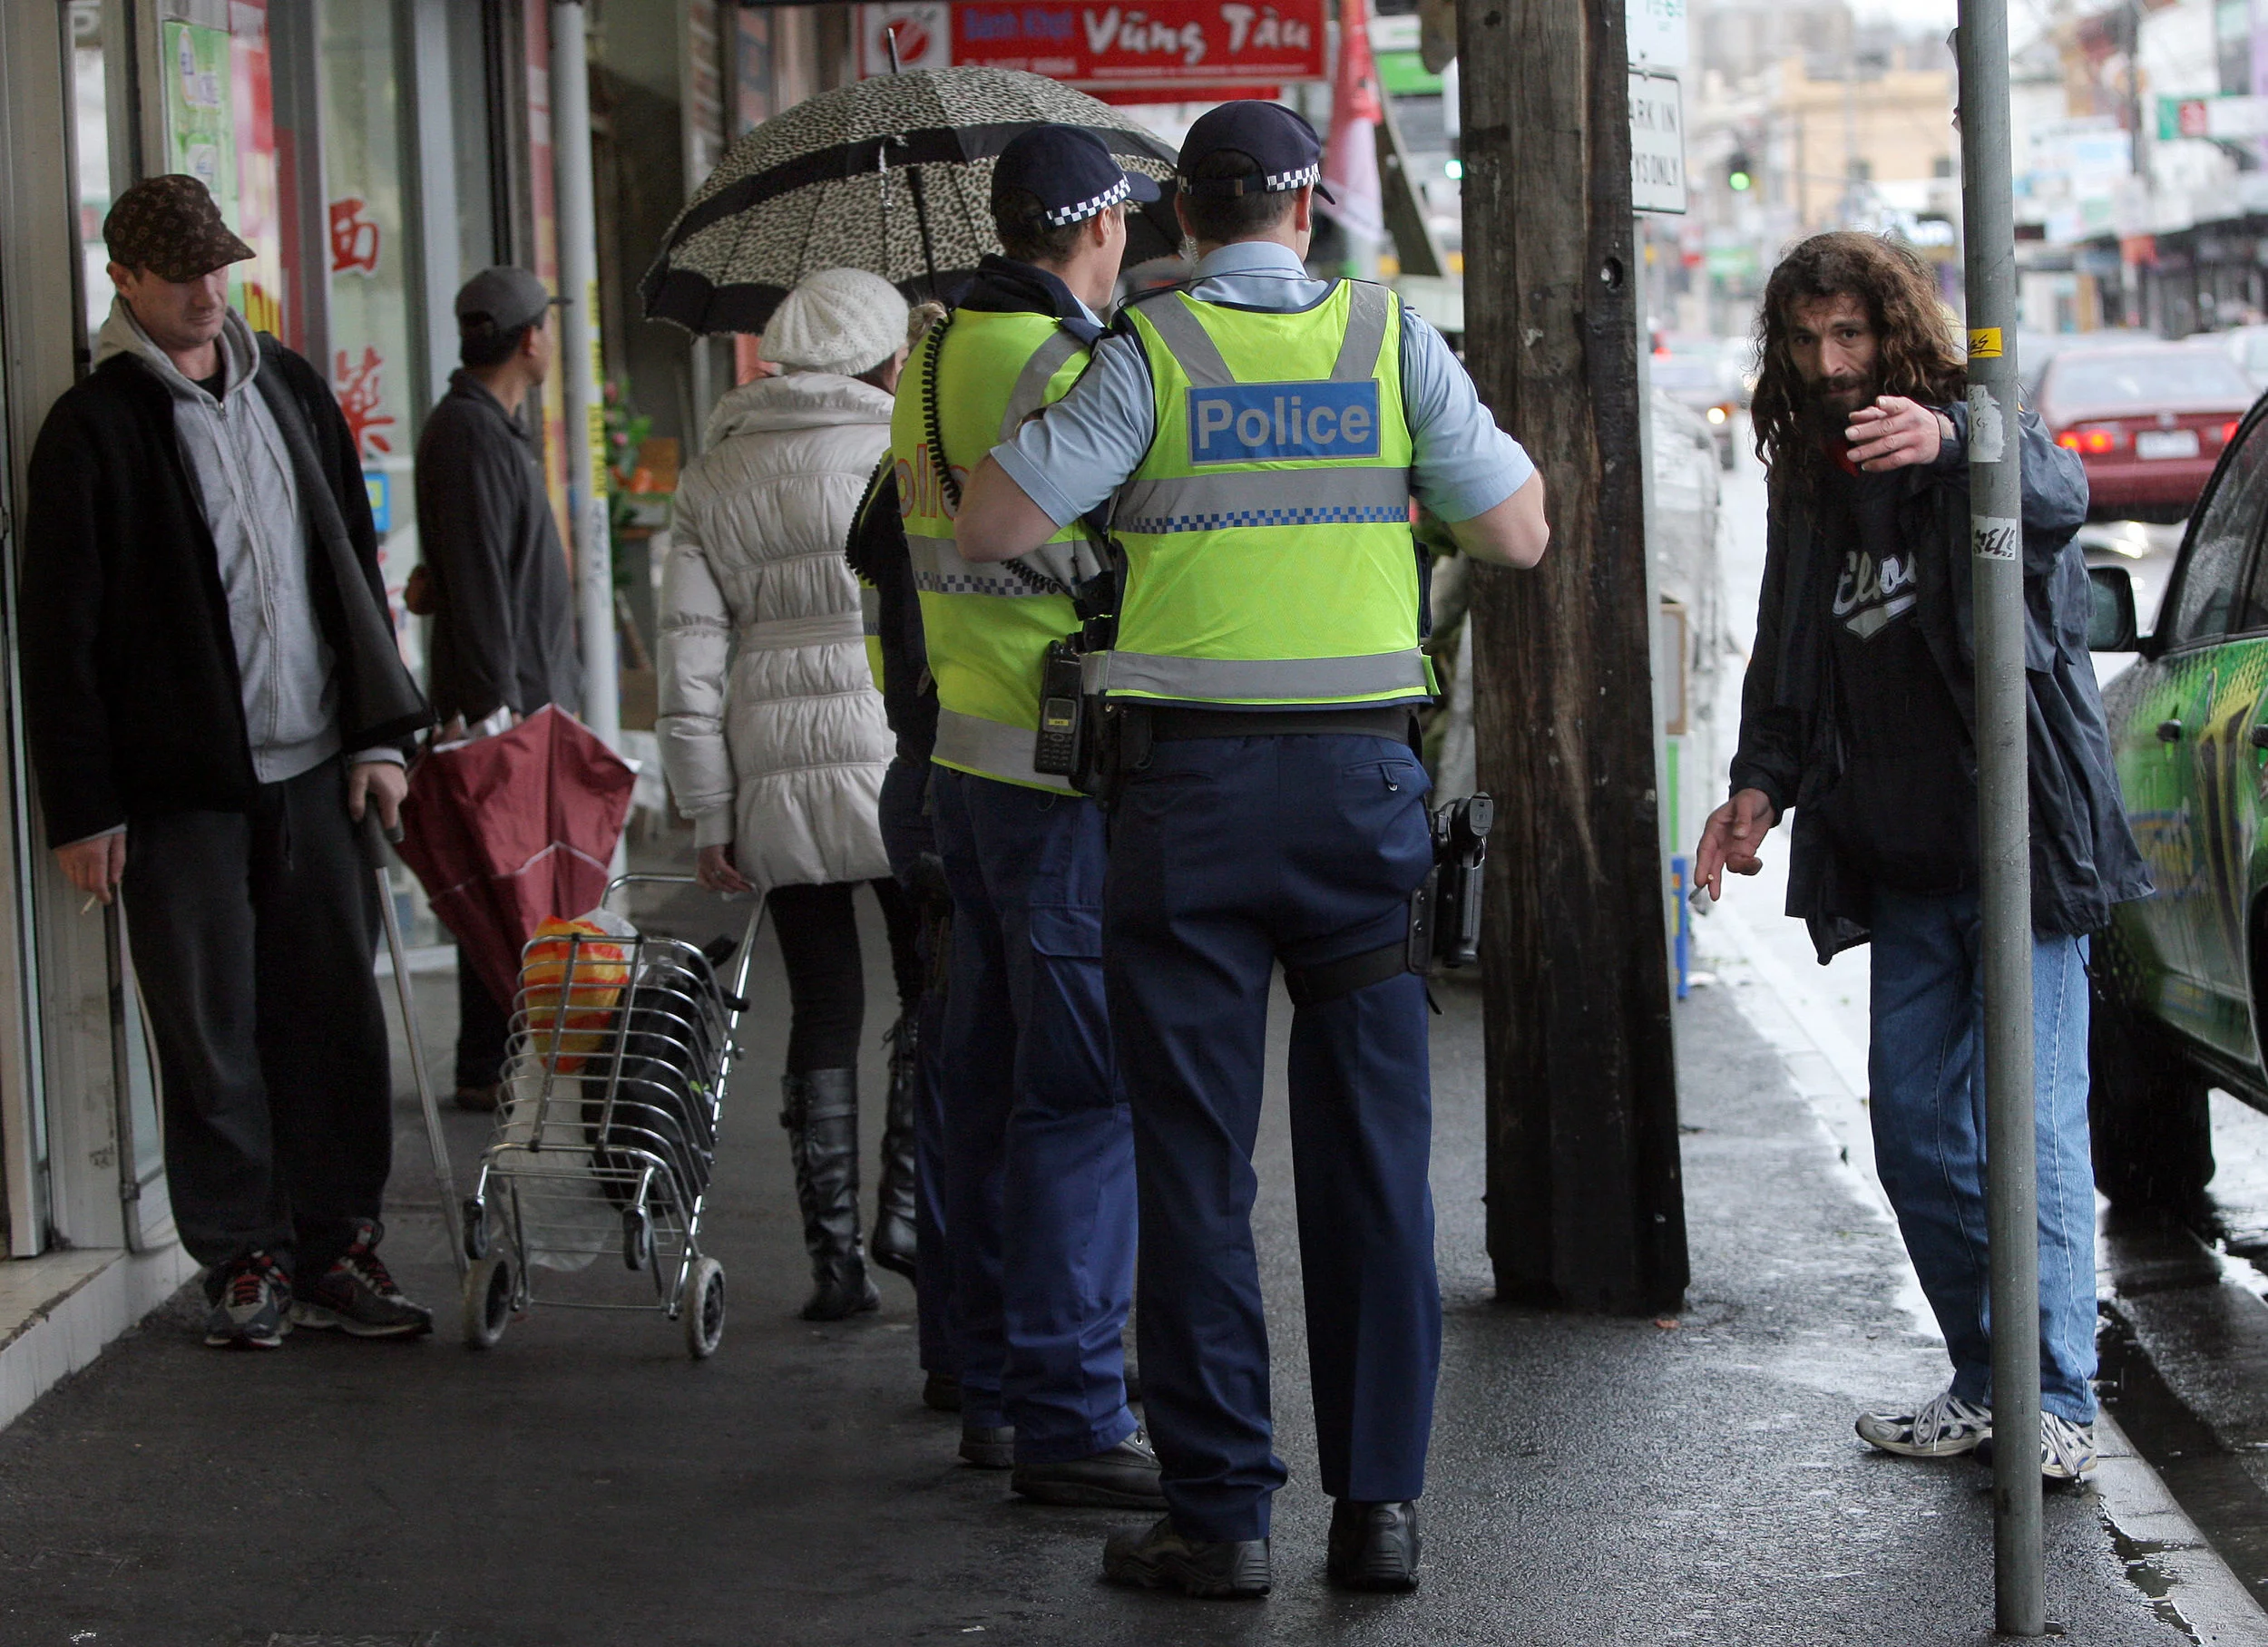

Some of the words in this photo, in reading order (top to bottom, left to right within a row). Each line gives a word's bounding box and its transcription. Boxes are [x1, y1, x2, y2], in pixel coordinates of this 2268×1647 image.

[1220, 4, 1312, 54] Tàu
[1198, 396, 1371, 449] Police
[895, 443, 970, 521] olic
